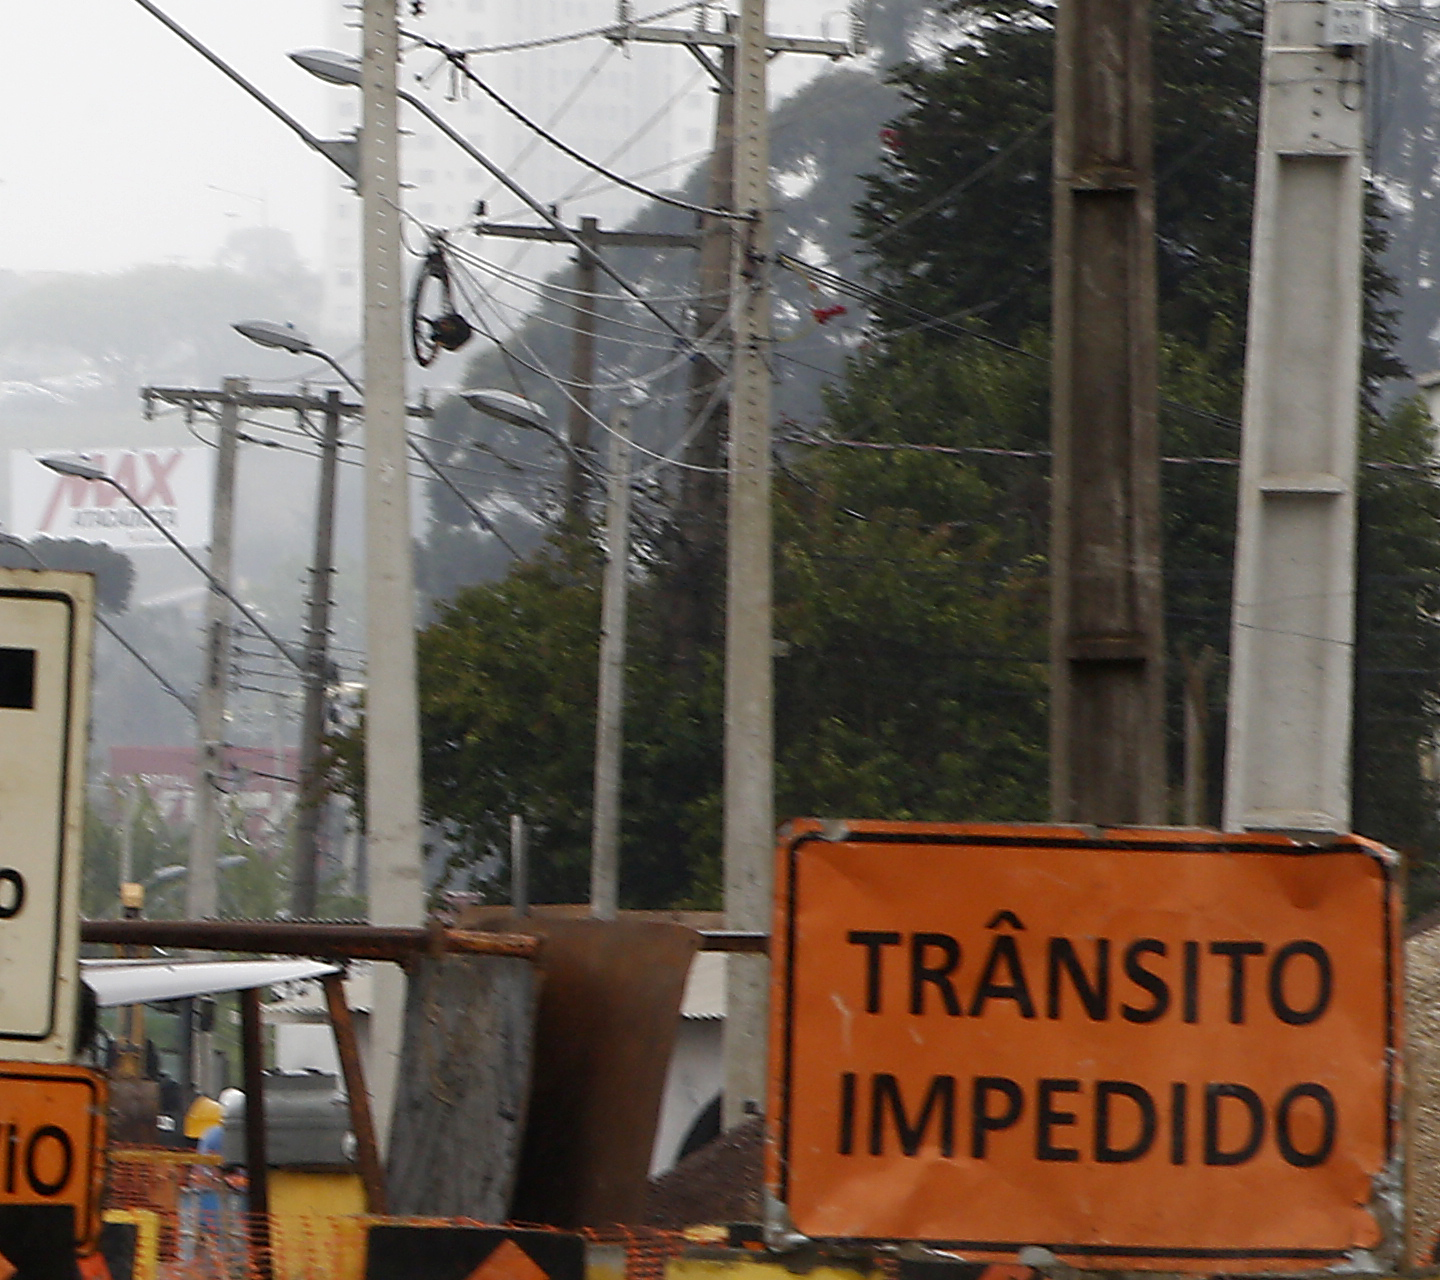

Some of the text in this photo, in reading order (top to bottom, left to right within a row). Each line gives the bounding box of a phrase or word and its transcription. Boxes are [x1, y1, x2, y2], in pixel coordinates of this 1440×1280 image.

[38, 452, 185, 532] MAX
[846, 909, 1335, 1027] TRÂNSITO
[837, 1071, 1339, 1169] IMPEDIDO
